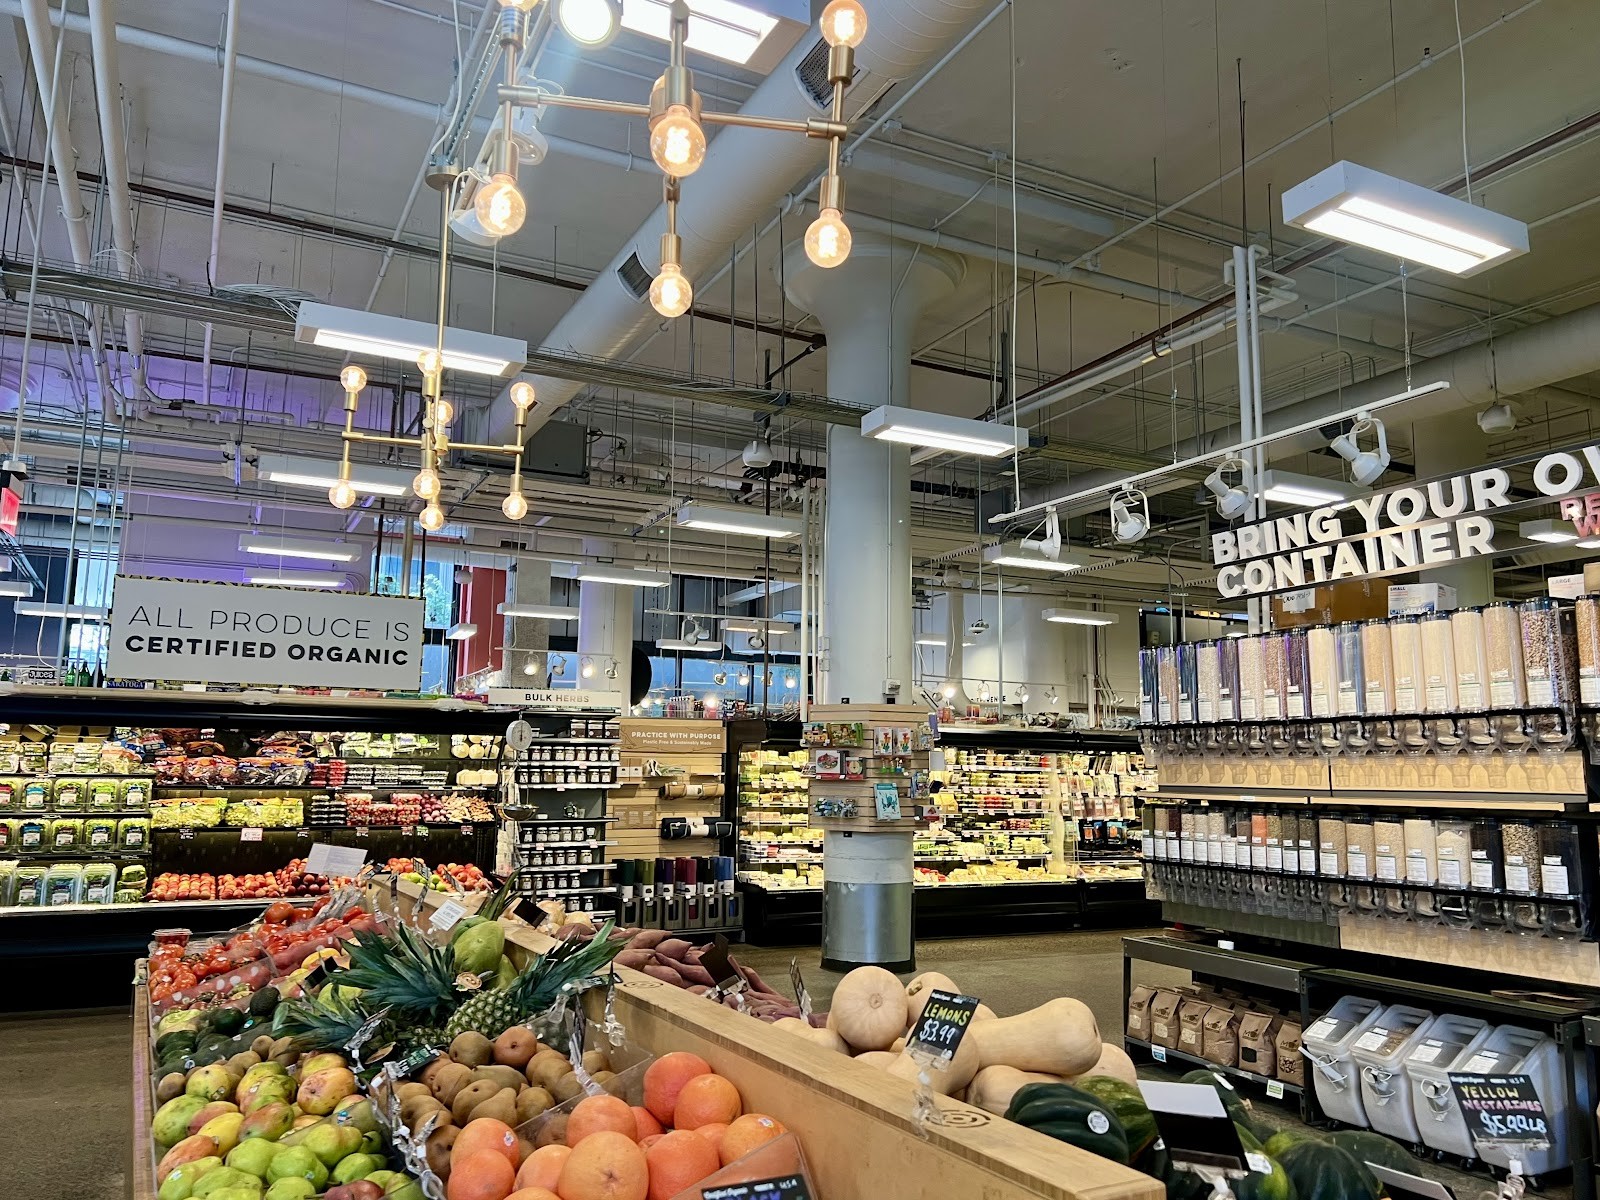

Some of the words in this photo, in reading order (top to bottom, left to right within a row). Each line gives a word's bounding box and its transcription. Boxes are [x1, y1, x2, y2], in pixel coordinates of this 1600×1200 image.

[1211, 507, 1342, 566] BRING
[1350, 467, 1512, 533] YOUR
[1532, 445, 1600, 497] O
[1216, 515, 1496, 599] CONTAINER
[128, 605, 193, 629] ALL
[210, 610, 371, 640] PRODUCE
[385, 621, 409, 642] IS
[125, 635, 277, 659] CERTIFIED
[287, 643, 409, 666] ORGANIC
[525, 693, 552, 702] BULK
[555, 694, 589, 703] HERBS
[631, 731, 667, 739] PRACTICE
[924, 1003, 970, 1026] LEMONS
[919, 1018, 956, 1044] $3.99
[1460, 1085, 1519, 1099] YELLOW
